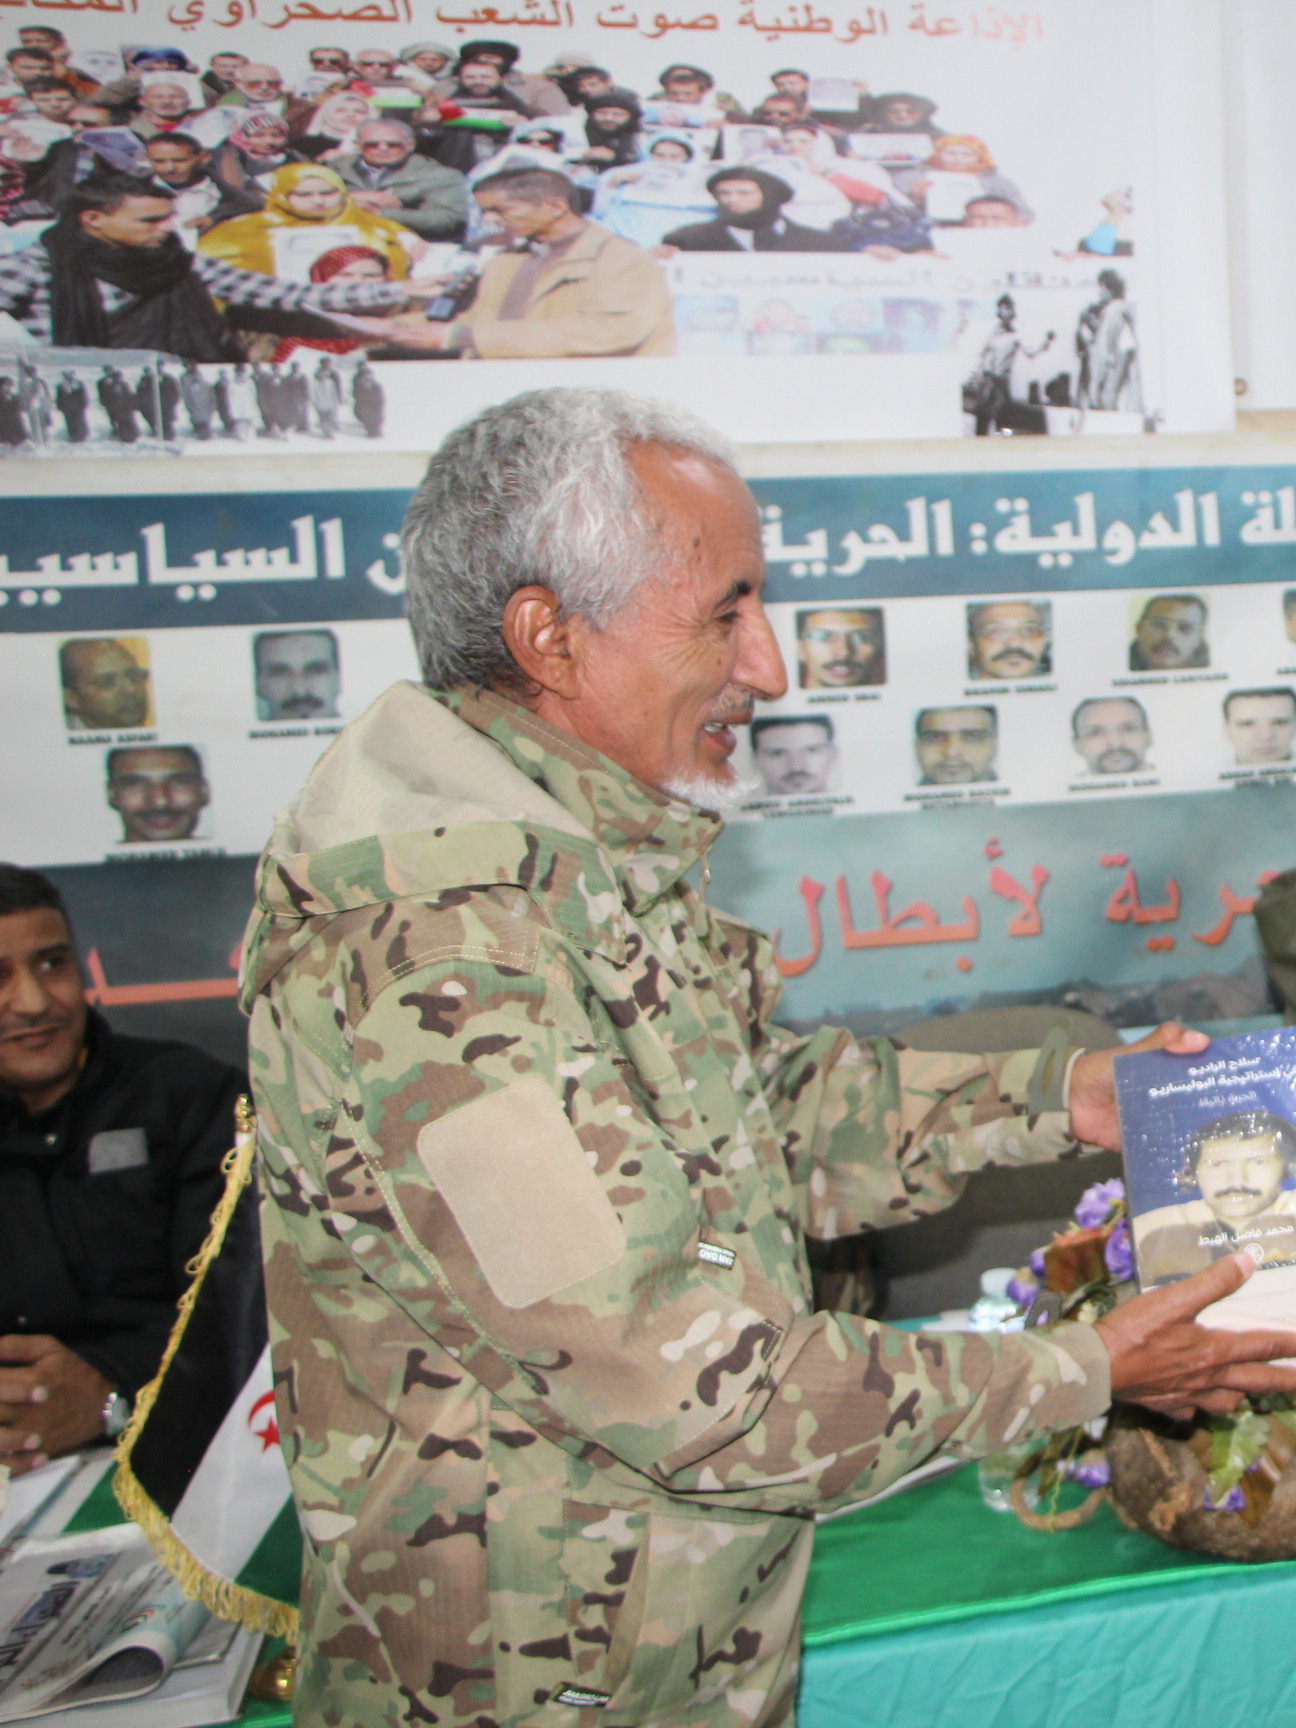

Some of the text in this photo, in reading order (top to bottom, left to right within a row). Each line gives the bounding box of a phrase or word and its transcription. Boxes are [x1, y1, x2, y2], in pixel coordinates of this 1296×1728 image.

[436, 0, 575, 34] الشعب
[597, 0, 720, 38] صوت
[737, 1, 889, 43] الوطنية
[0, 513, 346, 607] السياسي
[774, 837, 1050, 977] لأبطال
[1188, 1056, 1261, 1077] سلاح الراديو
[1147, 1076, 1217, 1099] البوليساريو
[1264, 1224, 1295, 1236] محمد
